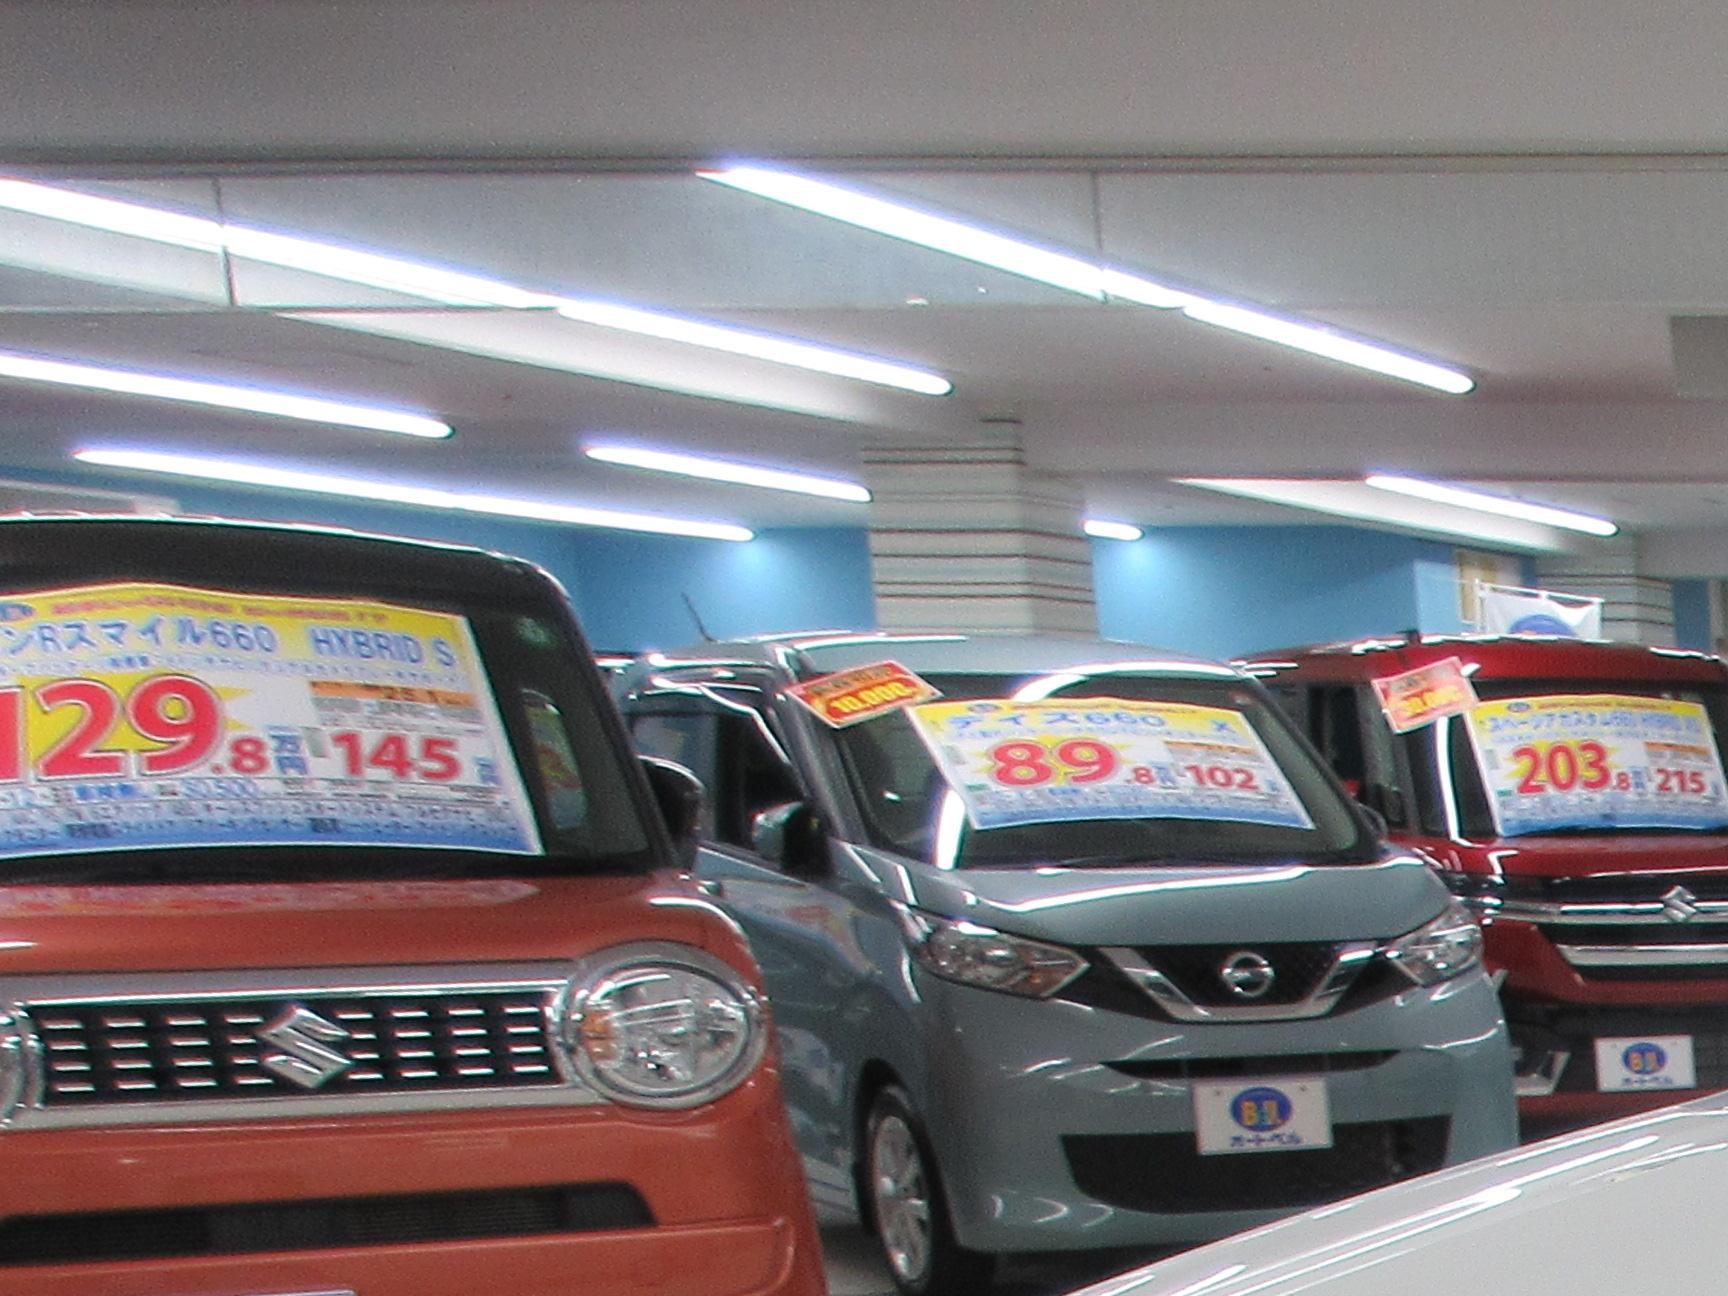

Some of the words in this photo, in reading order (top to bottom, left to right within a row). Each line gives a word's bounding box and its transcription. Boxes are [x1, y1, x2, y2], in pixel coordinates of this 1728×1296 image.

[309, 625, 425, 665] HYBRID
[430, 636, 457, 668] S
[330, 730, 463, 783] 145
[1184, 764, 1260, 791] 102
[1656, 767, 1707, 794] 215
